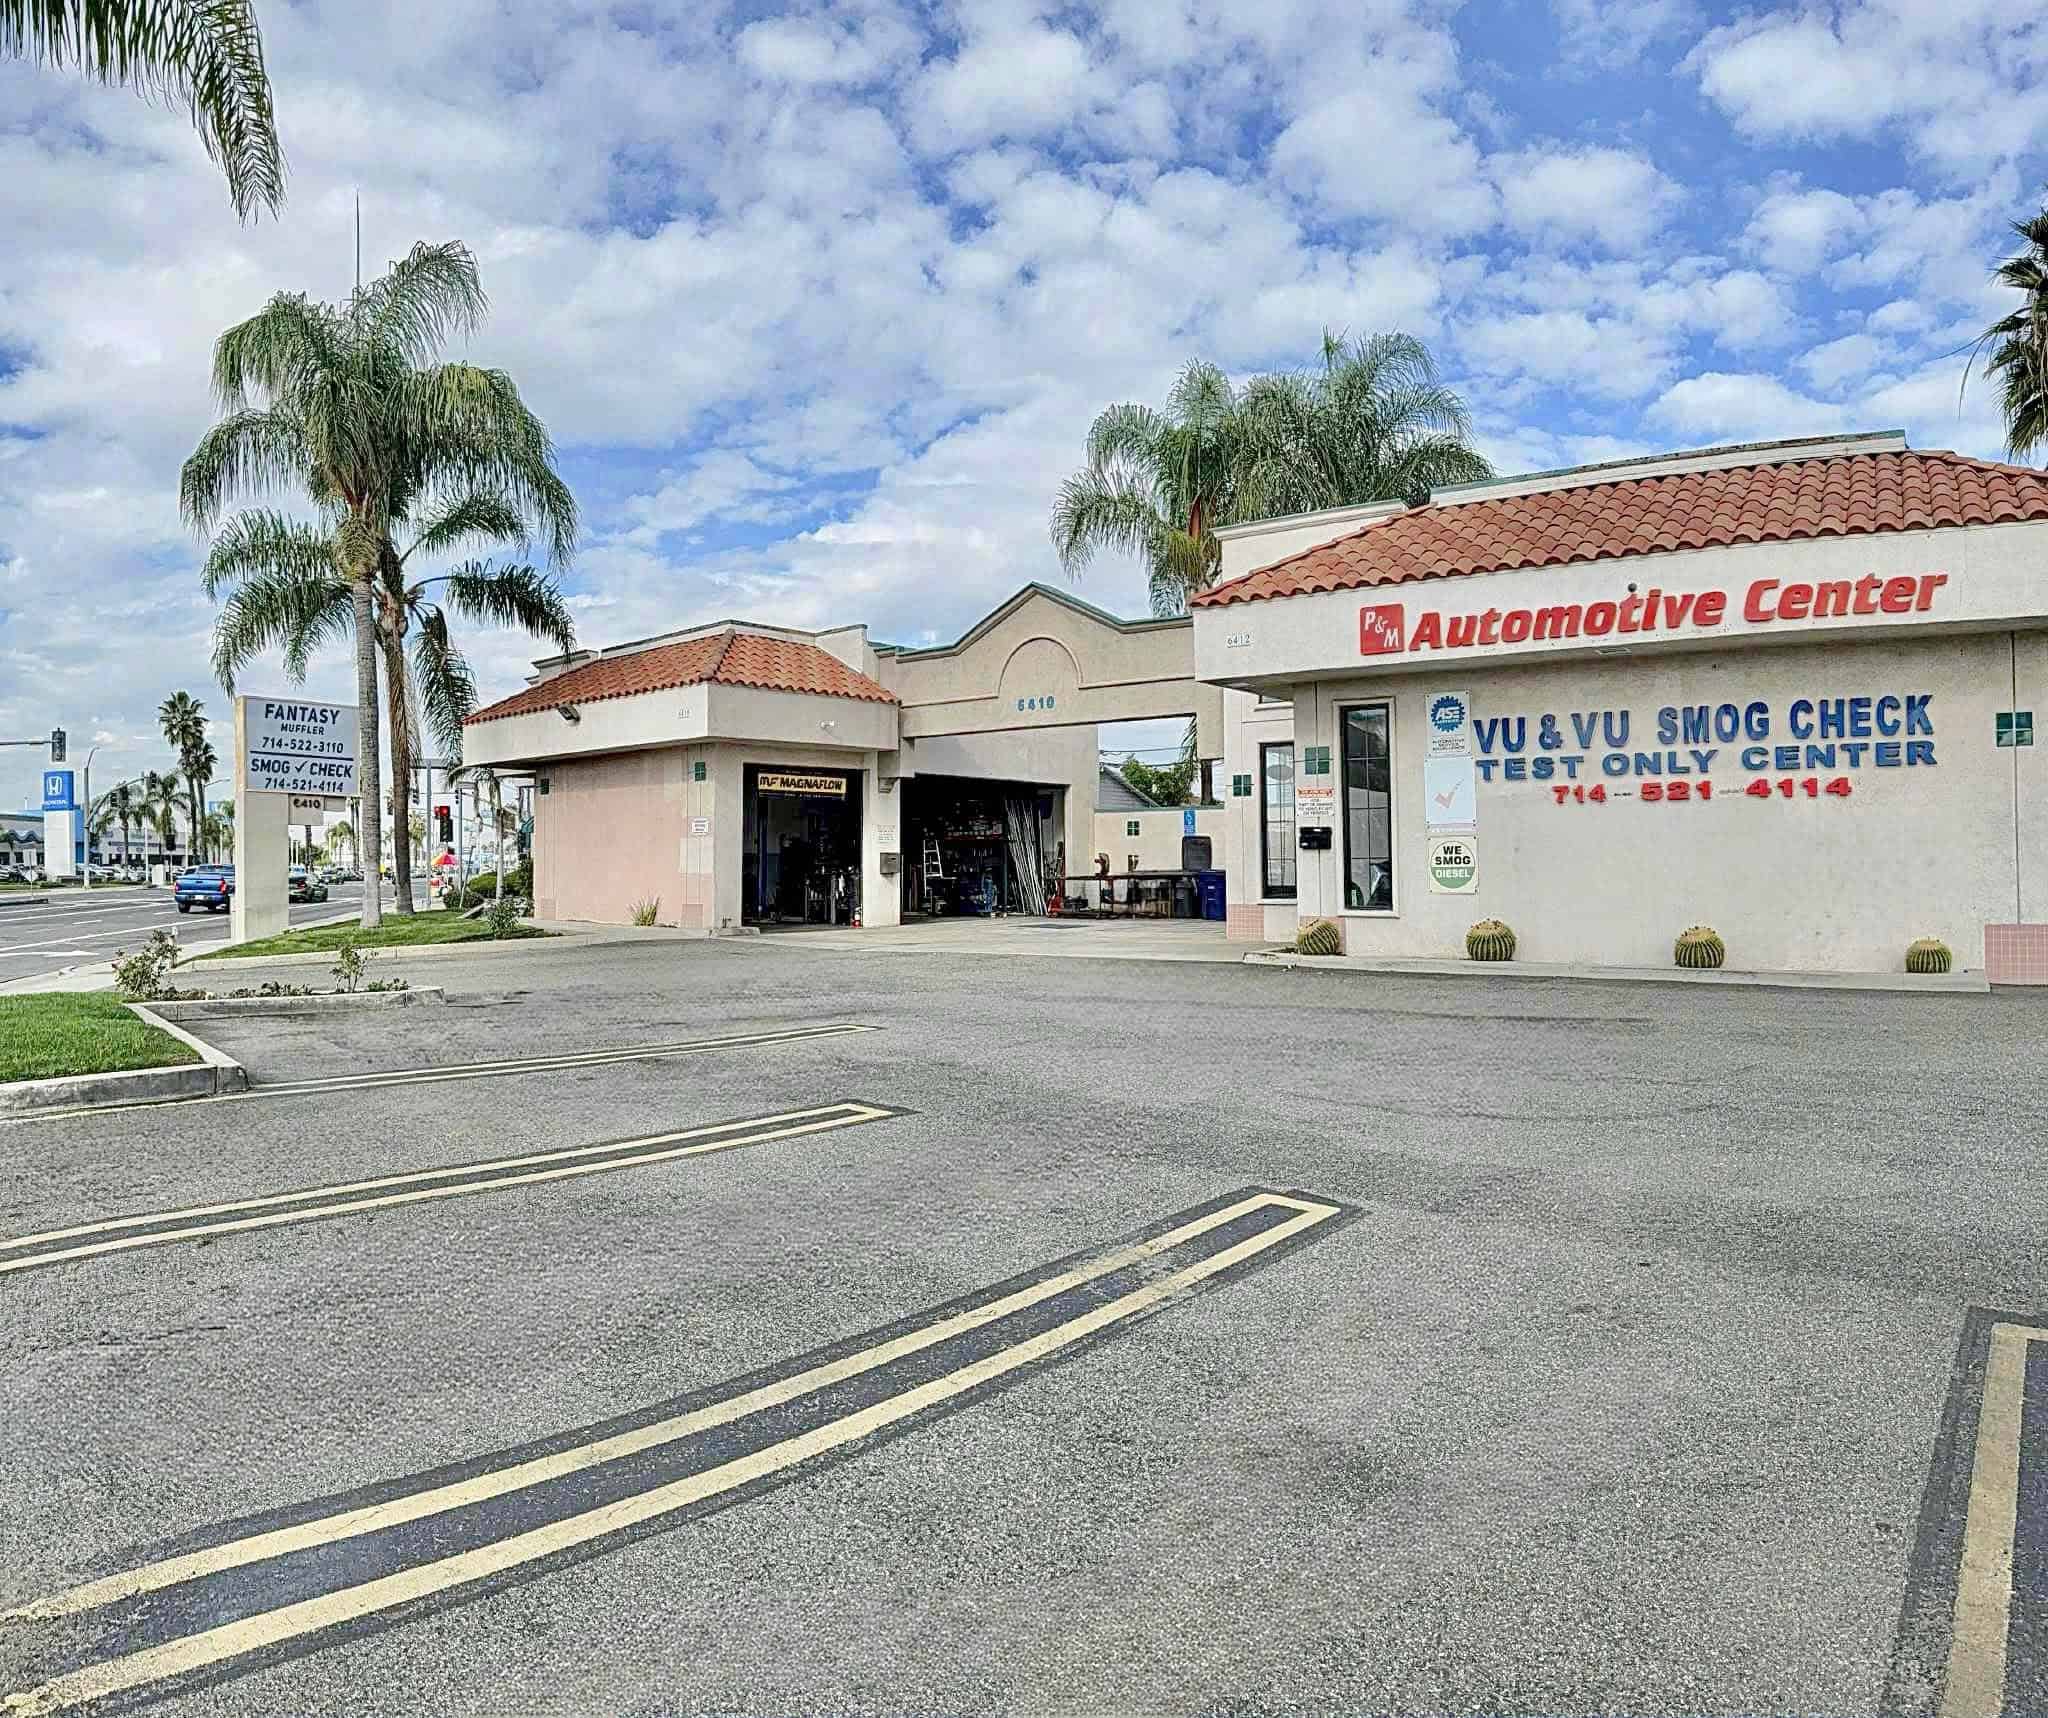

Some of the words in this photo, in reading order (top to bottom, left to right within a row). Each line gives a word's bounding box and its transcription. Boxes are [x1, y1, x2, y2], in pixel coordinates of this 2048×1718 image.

[1364, 611, 1399, 648] P&M
[1409, 589, 1727, 651] Automotive
[1744, 573, 1948, 622] Center
[1018, 696, 1055, 711] 6410
[265, 703, 340, 724] FANTASY
[1436, 707, 1460, 720] ASE
[281, 723, 325, 735] MUFFLER
[1473, 717, 1526, 753] VU
[1539, 714, 1562, 750] &
[1571, 710, 1629, 748] VU
[1657, 702, 1769, 744] SMOG
[1790, 694, 1934, 739] CHECK
[262, 737, 344, 754] 714-522-3110
[1475, 755, 1584, 782] TEST
[1602, 750, 1717, 776] ONLY
[1742, 740, 1937, 770] CENTER
[251, 759, 290, 774] SMOG
[309, 763, 353, 778] CHECK
[264, 778, 344, 792] 714-521-4114
[780, 778, 843, 791] MAGNAFLOW
[1443, 845, 1462, 855] WE
[1435, 856, 1471, 865] SMOG
[1436, 868, 1471, 878] DIESEL
